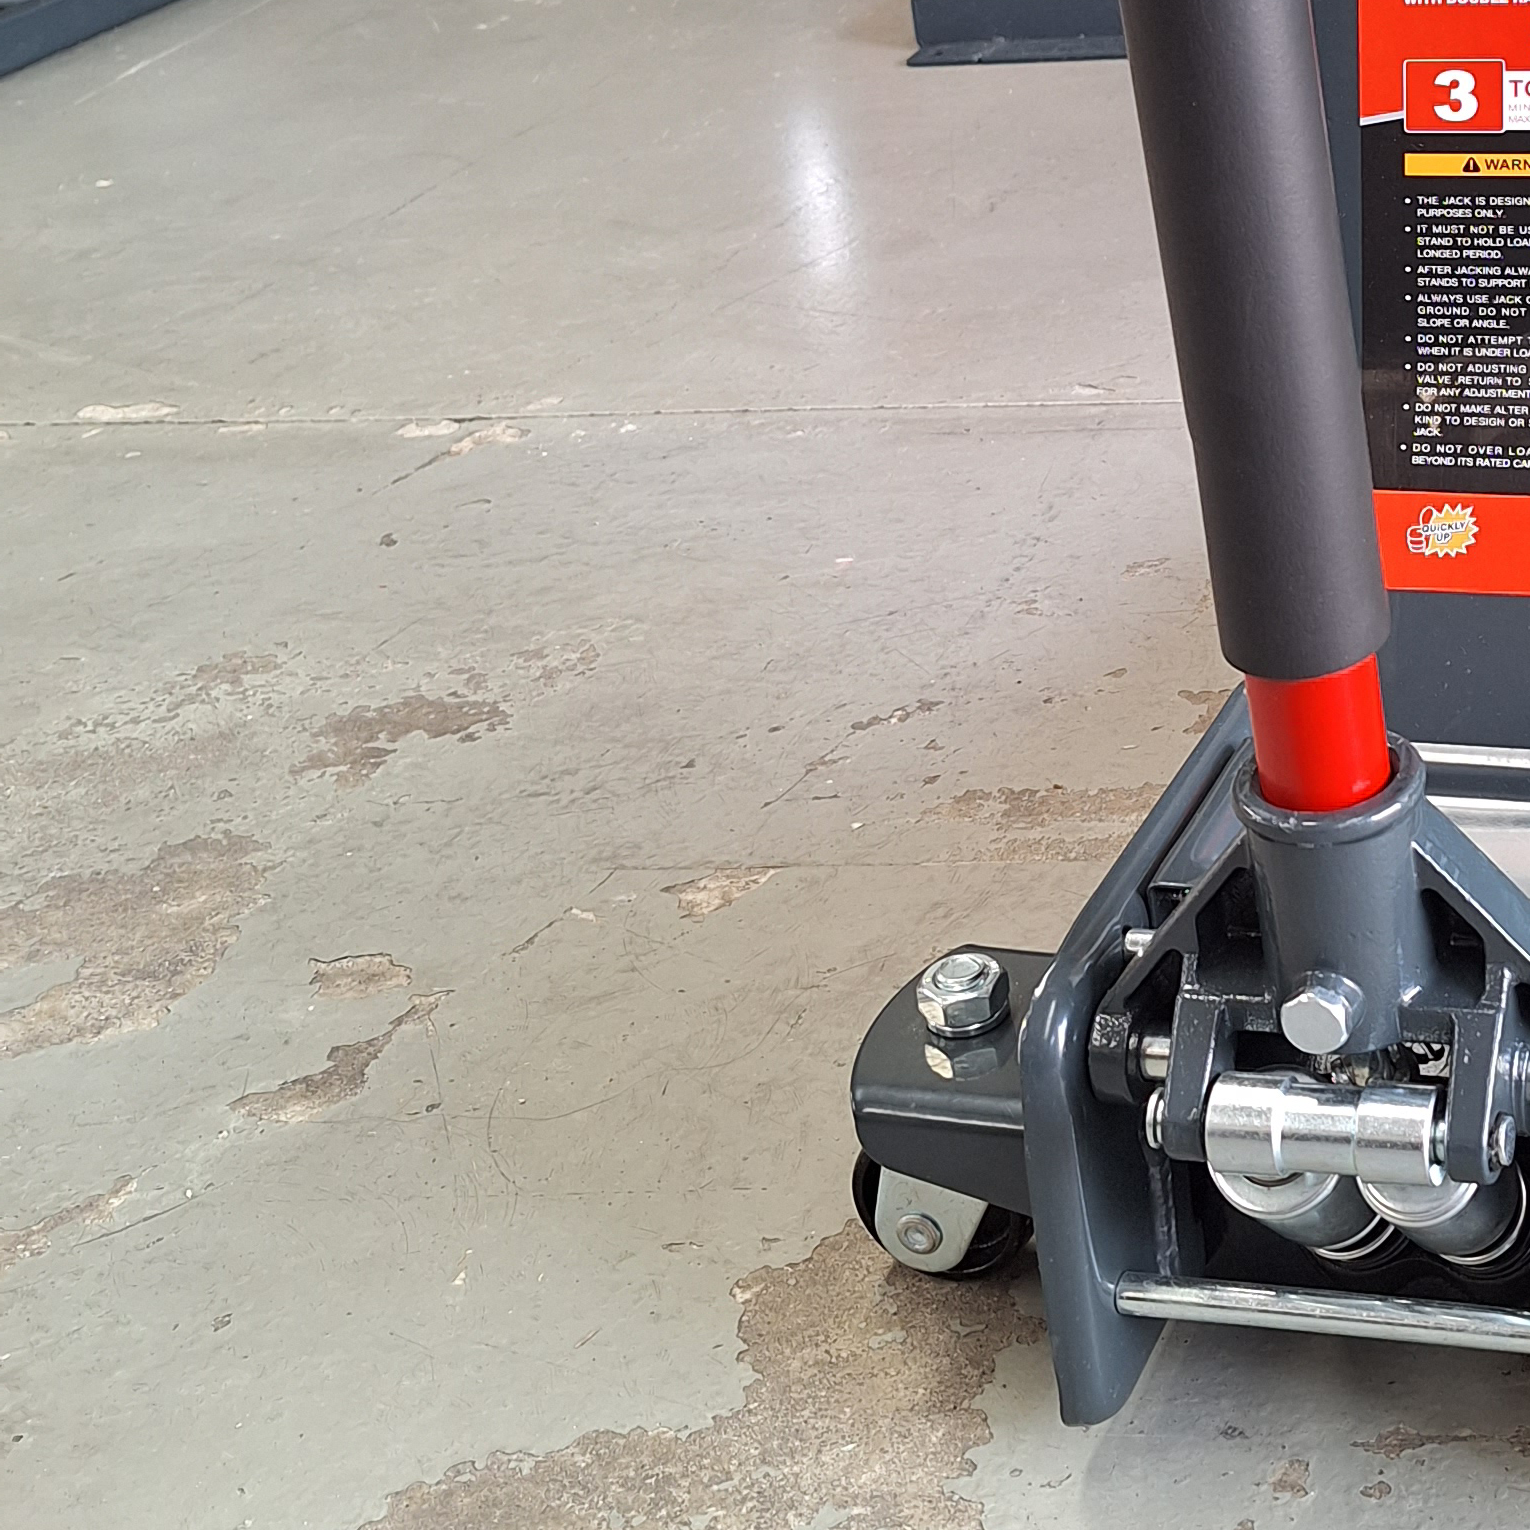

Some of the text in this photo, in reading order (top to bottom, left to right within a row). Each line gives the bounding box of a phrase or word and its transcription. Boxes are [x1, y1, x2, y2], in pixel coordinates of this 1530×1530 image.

[1433, 69, 1478, 122] 3
[1508, 115, 1530, 123] MAX
[1417, 197, 1439, 205] THE
[1443, 197, 1472, 205] JACK
[1476, 197, 1486, 205] IS
[1417, 209, 1472, 218] PURPOSES
[1417, 225, 1428, 233] IT
[1433, 225, 1465, 234] MUST
[1470, 226, 1495, 234] NOT
[1499, 226, 1514, 234] BE
[1417, 237, 1452, 246] STAND
[1456, 238, 1471, 246] TO
[1474, 238, 1504, 246] HOLD
[1417, 250, 1460, 258] LONGED
[1417, 266, 1451, 275] AFTER
[1454, 267, 1500, 275] JACKING
[1417, 278, 1458, 287] STANDS
[1462, 279, 1476, 287] TO
[1478, 279, 1527, 288] SUPPORT
[1417, 295, 1463, 303] ALWAYS
[1467, 295, 1489, 303] USE
[1492, 295, 1522, 304] JACK
[1479, 308, 1496, 316] DO
[1502, 308, 1527, 316] NOT
[1417, 319, 1451, 328] SLOPE
[1454, 320, 1469, 328] OR
[1417, 335, 1434, 343] DO
[1439, 335, 1463, 344] NOT
[1467, 336, 1523, 345] ATTEMPT
[1417, 347, 1448, 356] WHEN
[1451, 348, 1460, 356] IT
[1463, 348, 1472, 356] IS
[1475, 348, 1510, 357] UNDER
[1417, 363, 1434, 372] DO
[1439, 364, 1463, 372] NOT
[1467, 364, 1527, 373] ADUSTING
[1417, 375, 1451, 384] VALVE
[1506, 378, 1521, 386] TO
[1417, 387, 1437, 396] FOR
[1439, 388, 1460, 397] ANY
[1415, 403, 1431, 412] DO
[1434, 404, 1457, 413] NOT
[1460, 405, 1491, 414] MAKE
[1494, 406, 1528, 415] ALTER
[1415, 415, 1442, 424] KIND
[1445, 416, 1460, 425] TO
[1464, 417, 1505, 426] DESIGN
[1509, 418, 1525, 427] OR
[1412, 444, 1430, 452] DO
[1436, 444, 1463, 453] NOT
[1468, 445, 1503, 455] OVER
[1412, 456, 1455, 465] BEYOND
[1458, 457, 1473, 466] ITS
[1476, 458, 1510, 467] RATED
[1436, 533, 1450, 542] UP
